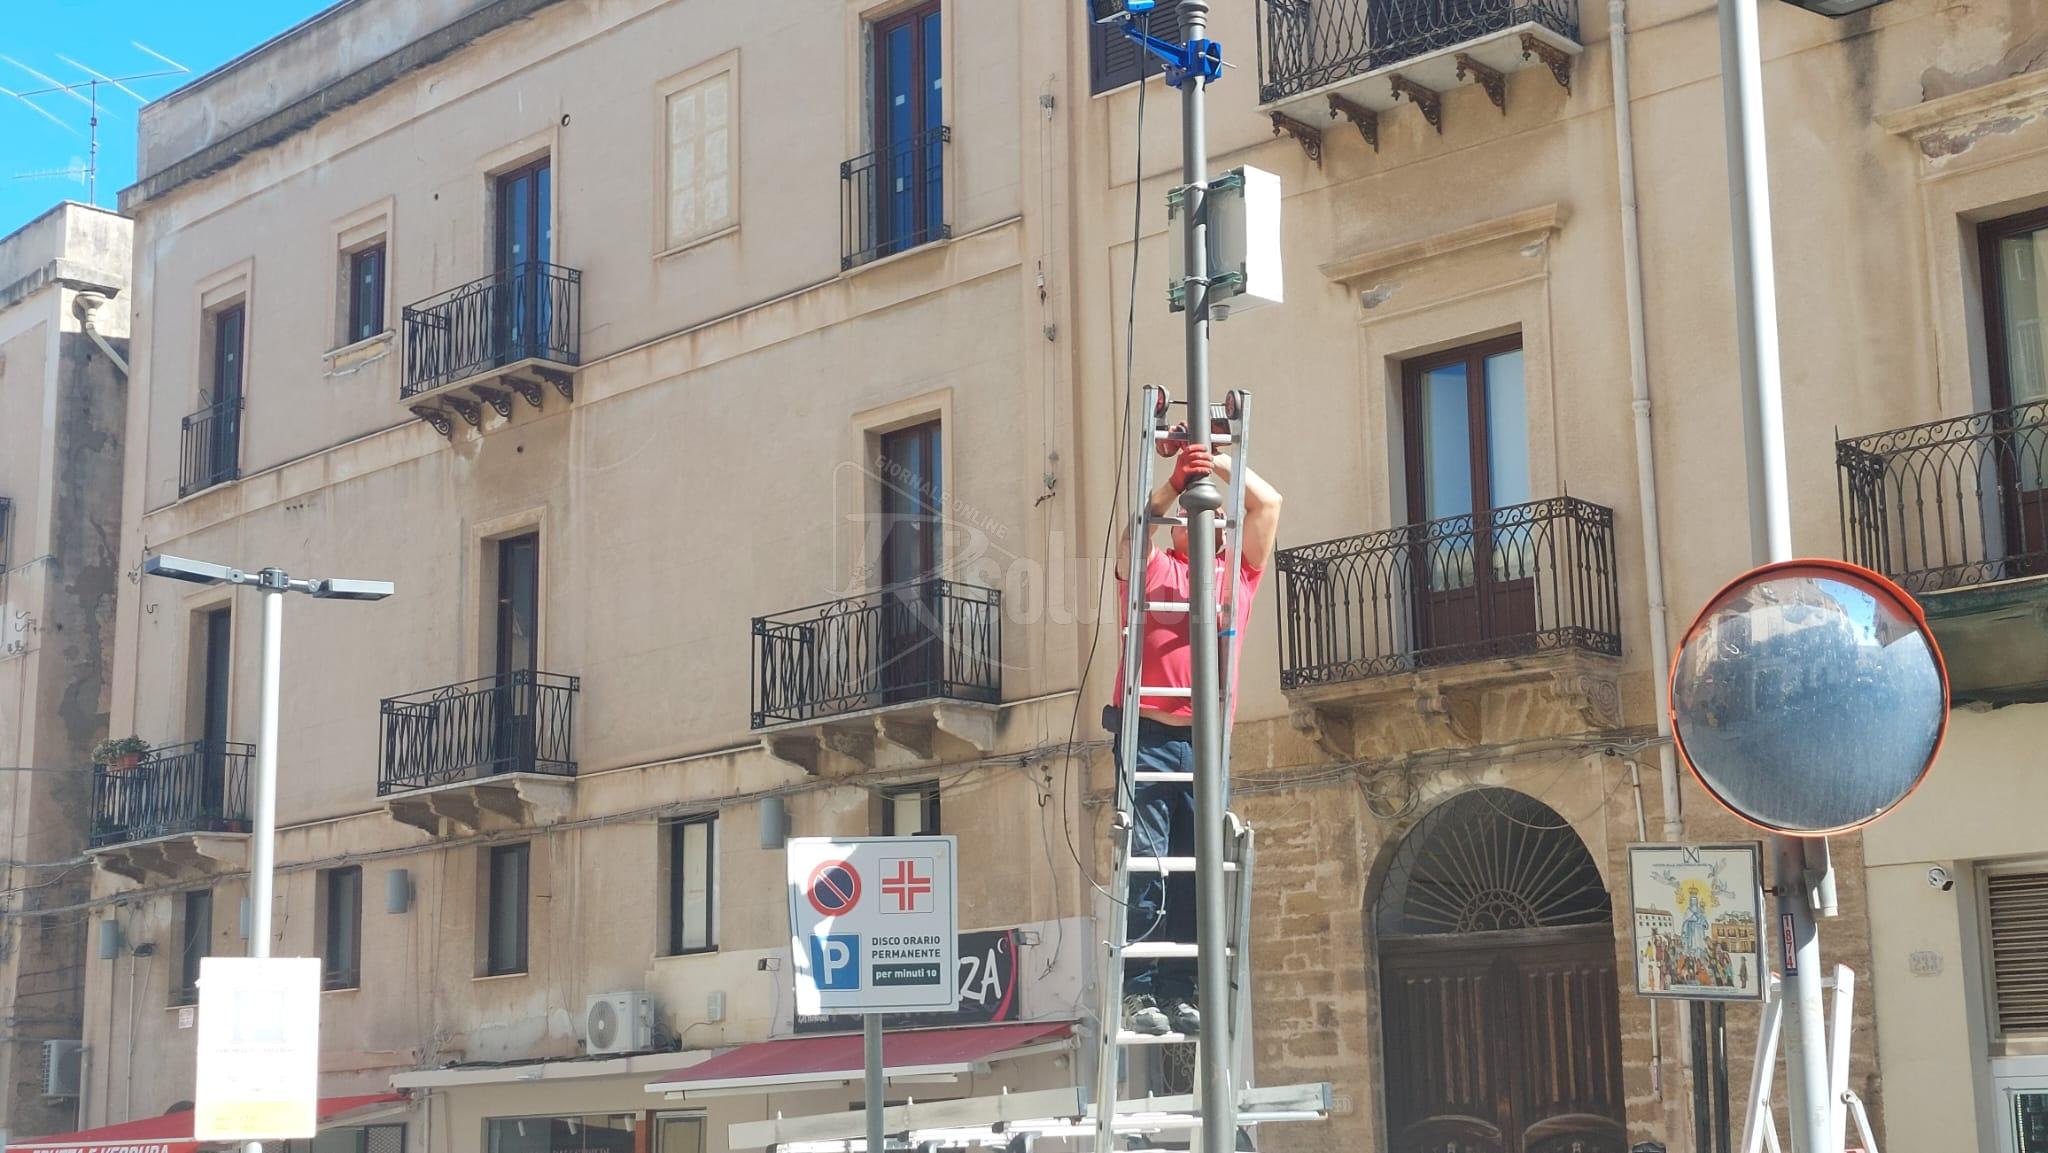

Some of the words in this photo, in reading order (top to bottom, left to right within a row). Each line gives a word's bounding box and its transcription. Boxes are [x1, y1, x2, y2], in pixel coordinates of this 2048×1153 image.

[872, 936, 900, 946] DISCO
[903, 935, 941, 945] ORARIO
[1783, 916, 1794, 968] 1874
[872, 949, 941, 959] PERMANENTE
[823, 941, 850, 985] P
[876, 971, 892, 980] per
[894, 969, 925, 979] minuti
[926, 969, 937, 977] 10
